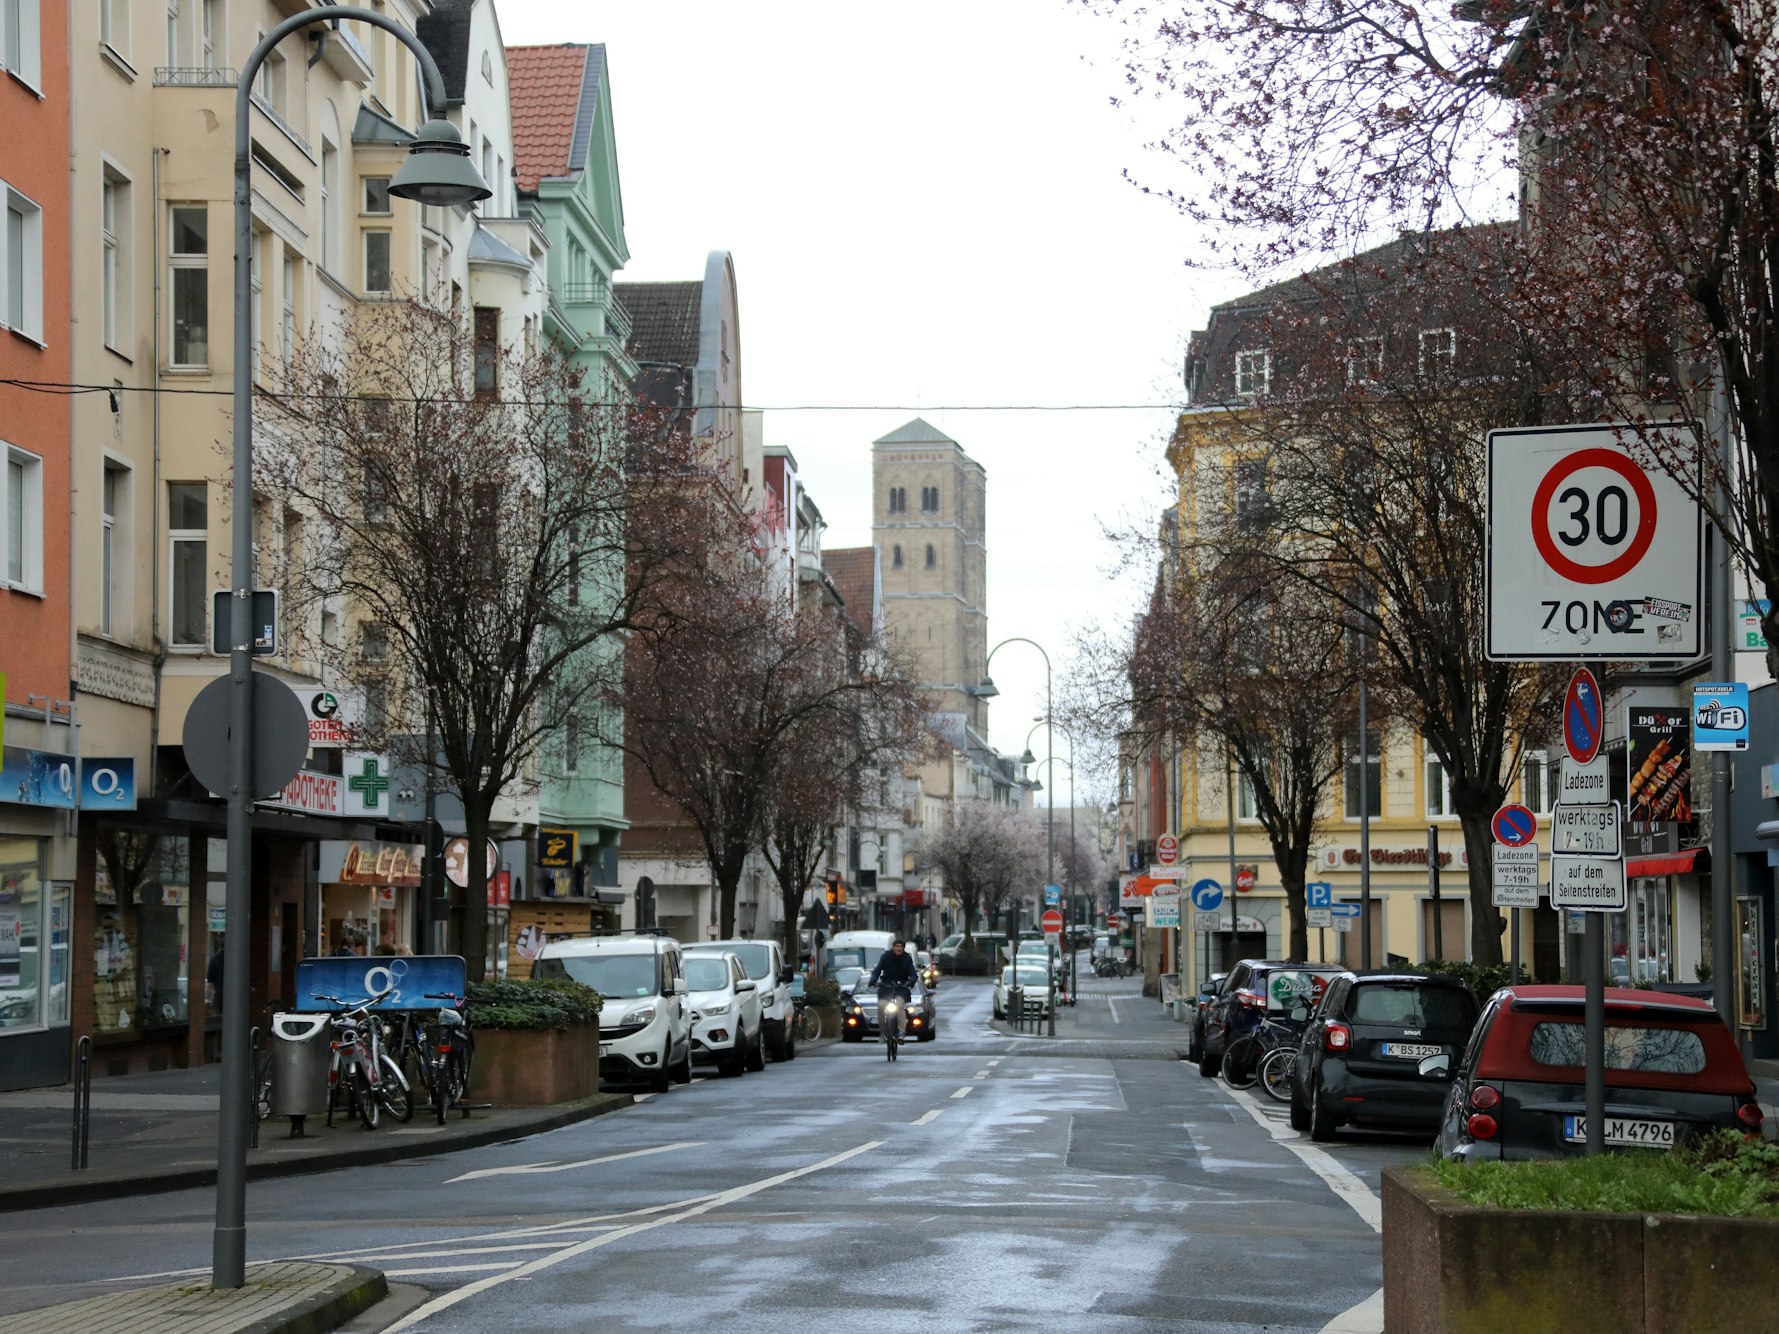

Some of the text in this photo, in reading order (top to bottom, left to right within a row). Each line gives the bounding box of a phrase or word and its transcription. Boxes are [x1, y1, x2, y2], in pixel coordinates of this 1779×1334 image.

[1558, 485, 1628, 547] 30
[1651, 598, 1682, 611] EISSPORT
[1651, 606, 1680, 619] VEREIN
[1649, 726, 1672, 734] Grill
[91, 768, 124, 800] O2
[1565, 771, 1604, 790] Ladezone
[1558, 807, 1614, 831] werktags
[1497, 850, 1534, 860] Ladezone
[1497, 865, 1537, 876] werktags
[1568, 863, 1604, 879] auf dem
[1503, 875, 1530, 884] 7-19h
[1311, 885, 1326, 906] P
[1504, 887, 1530, 895] auf dem
[1558, 883, 1616, 900] Seitenstreifen
[1496, 894, 1535, 905] Sitenstreifen
[364, 966, 401, 1004] O2
[1278, 978, 1323, 993] Diana
[1387, 1044, 1440, 1056] K BS 1257
[1576, 1118, 1587, 1136] K
[1627, 1122, 1672, 1142] 4796
